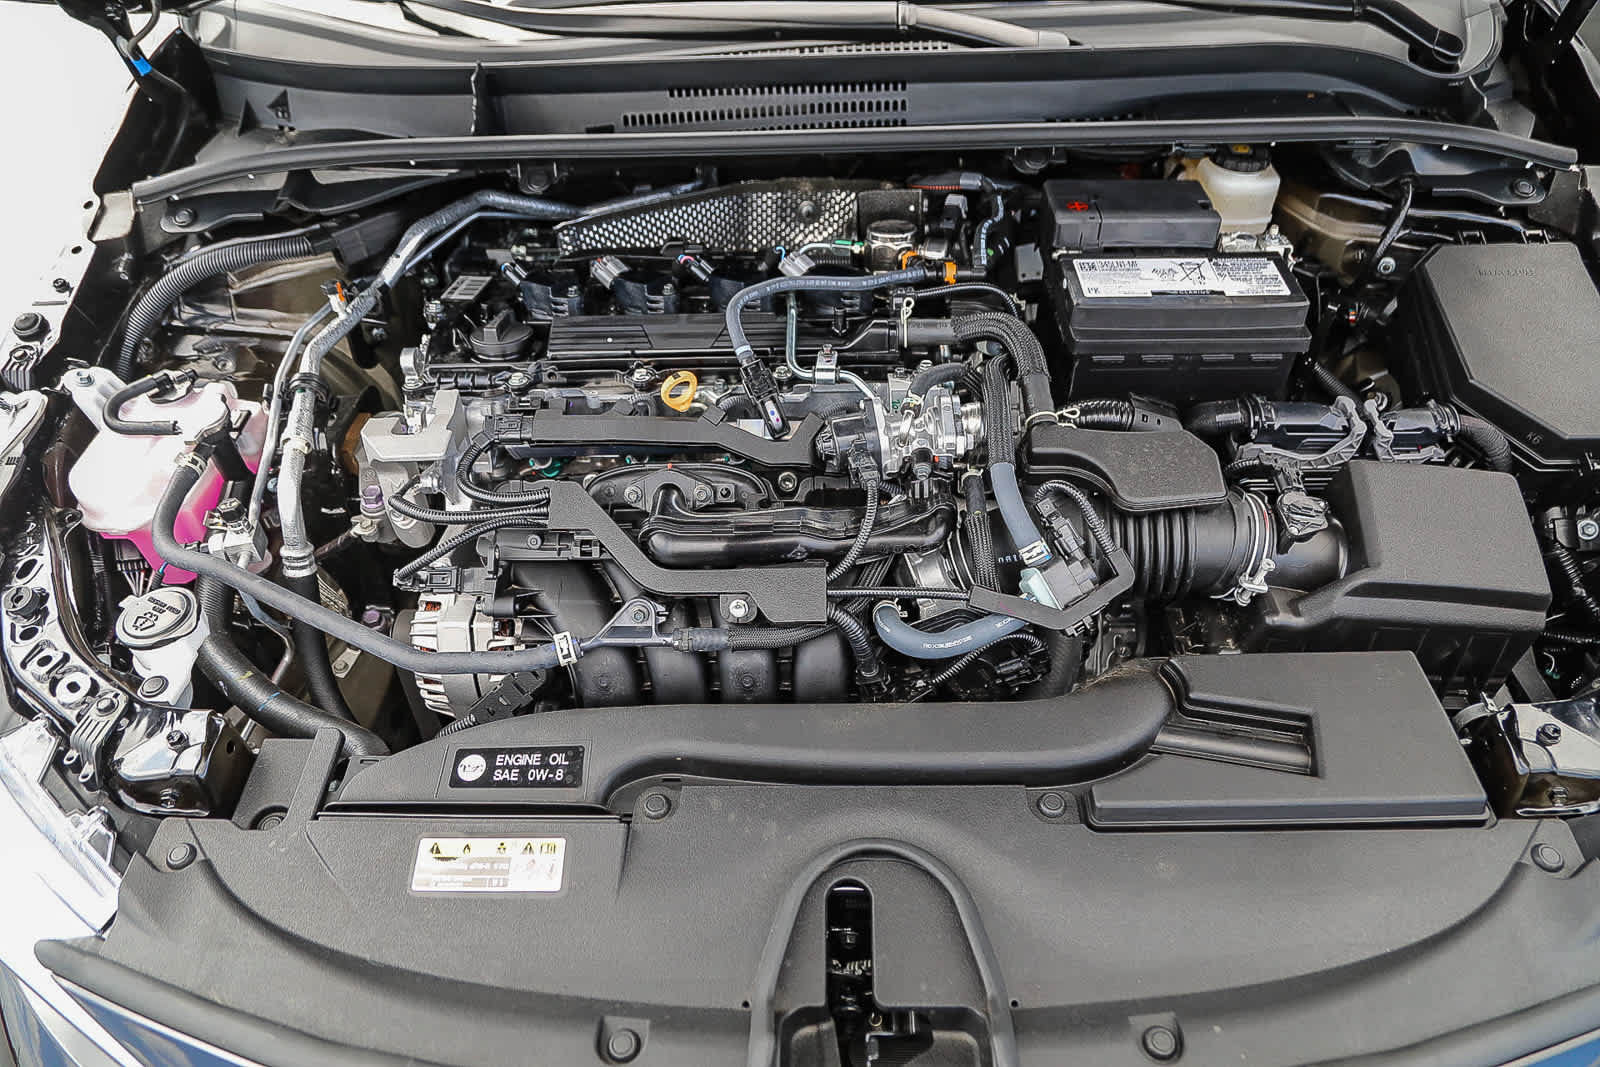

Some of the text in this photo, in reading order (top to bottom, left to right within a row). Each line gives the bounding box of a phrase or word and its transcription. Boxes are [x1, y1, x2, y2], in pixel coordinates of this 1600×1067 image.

[495, 753, 569, 766] ENGINE OIL
[493, 768, 564, 781] SAE 0W-8
